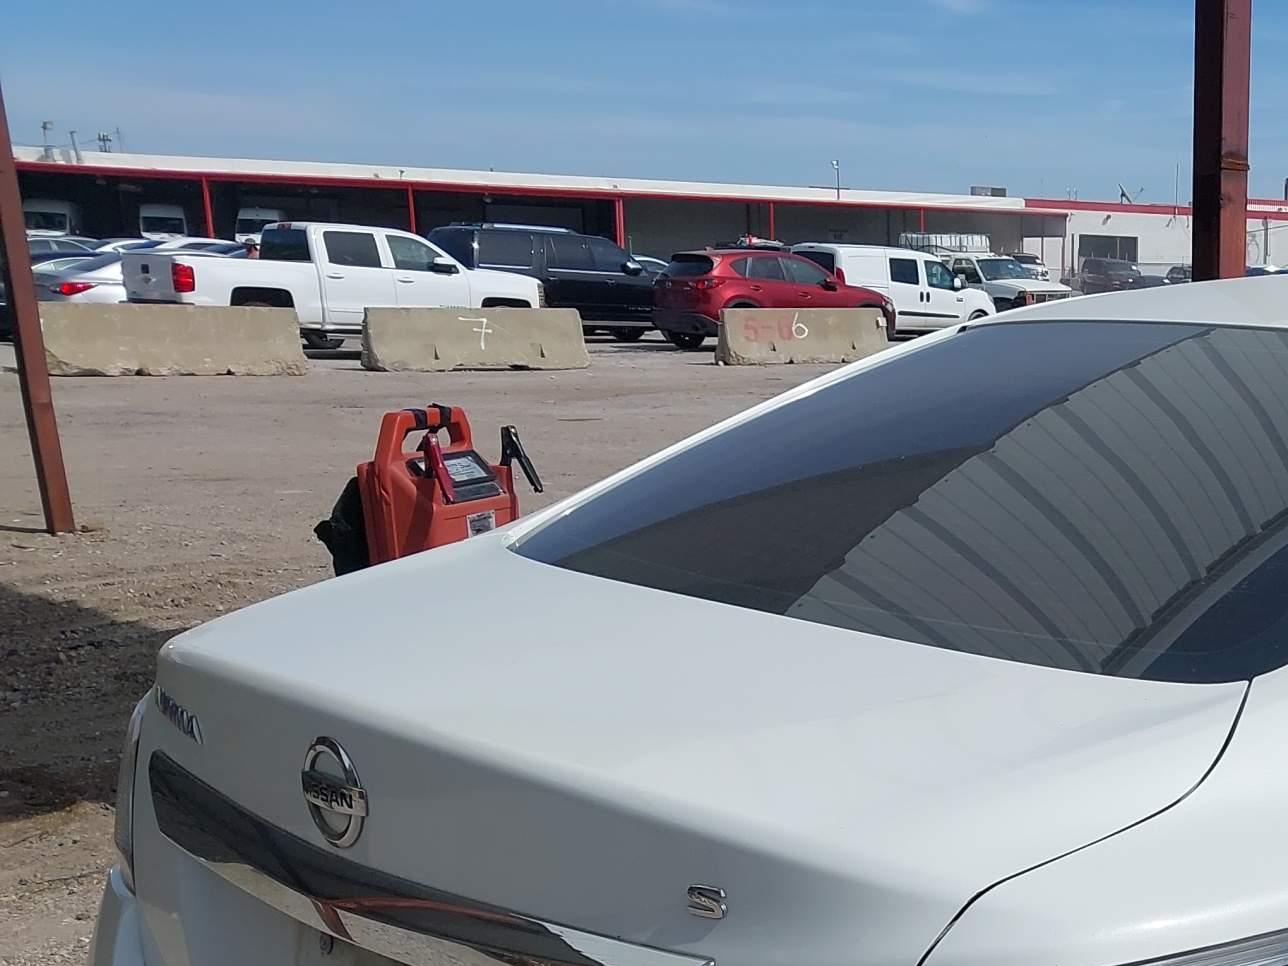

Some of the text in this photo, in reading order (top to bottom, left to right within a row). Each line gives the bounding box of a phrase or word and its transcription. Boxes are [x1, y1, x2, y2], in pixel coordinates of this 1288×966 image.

[458, 317, 493, 349] 7
[304, 780, 354, 809] NISSAN
[687, 884, 727, 919] S
